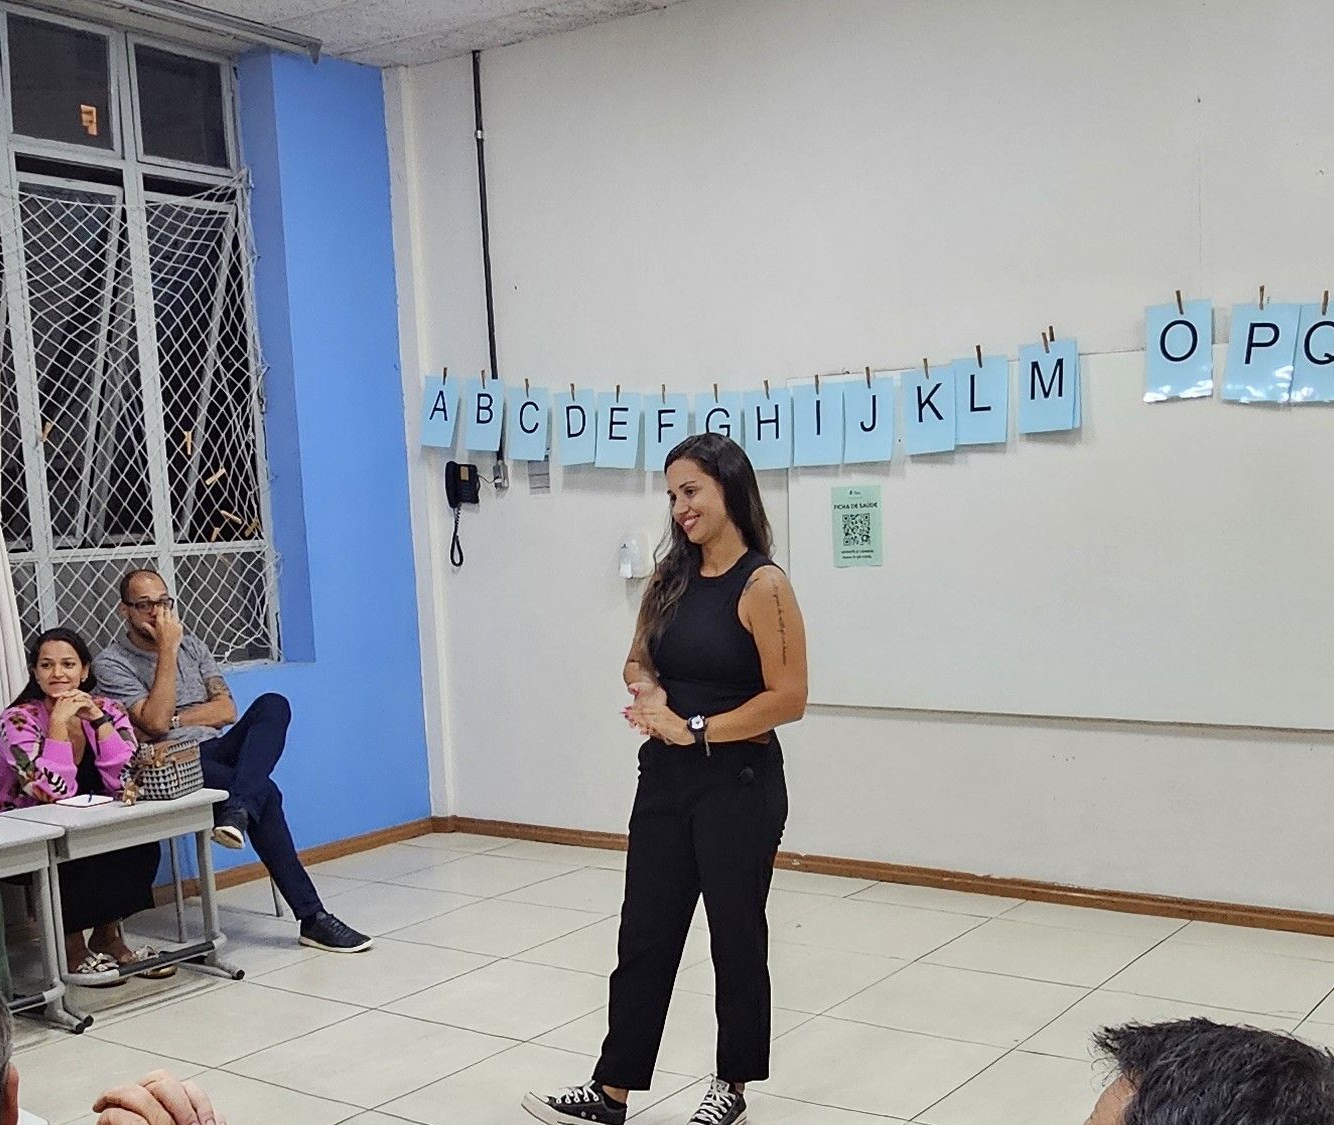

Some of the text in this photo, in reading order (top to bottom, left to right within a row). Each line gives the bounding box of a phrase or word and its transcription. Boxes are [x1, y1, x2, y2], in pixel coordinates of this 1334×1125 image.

[428, 390, 448, 422] A
[476, 392, 494, 425] B
[519, 401, 540, 434] C
[565, 405, 586, 439] D
[608, 407, 629, 441] E
[657, 409, 676, 444] F
[705, 407, 731, 438] G
[756, 403, 780, 441] H
[815, 399, 821, 436] I
[860, 394, 877, 433] J
[916, 382, 944, 423] K
[969, 374, 992, 413] L
[1030, 357, 1064, 401] M
[1159, 319, 1198, 362] O
[1244, 322, 1280, 365] P
